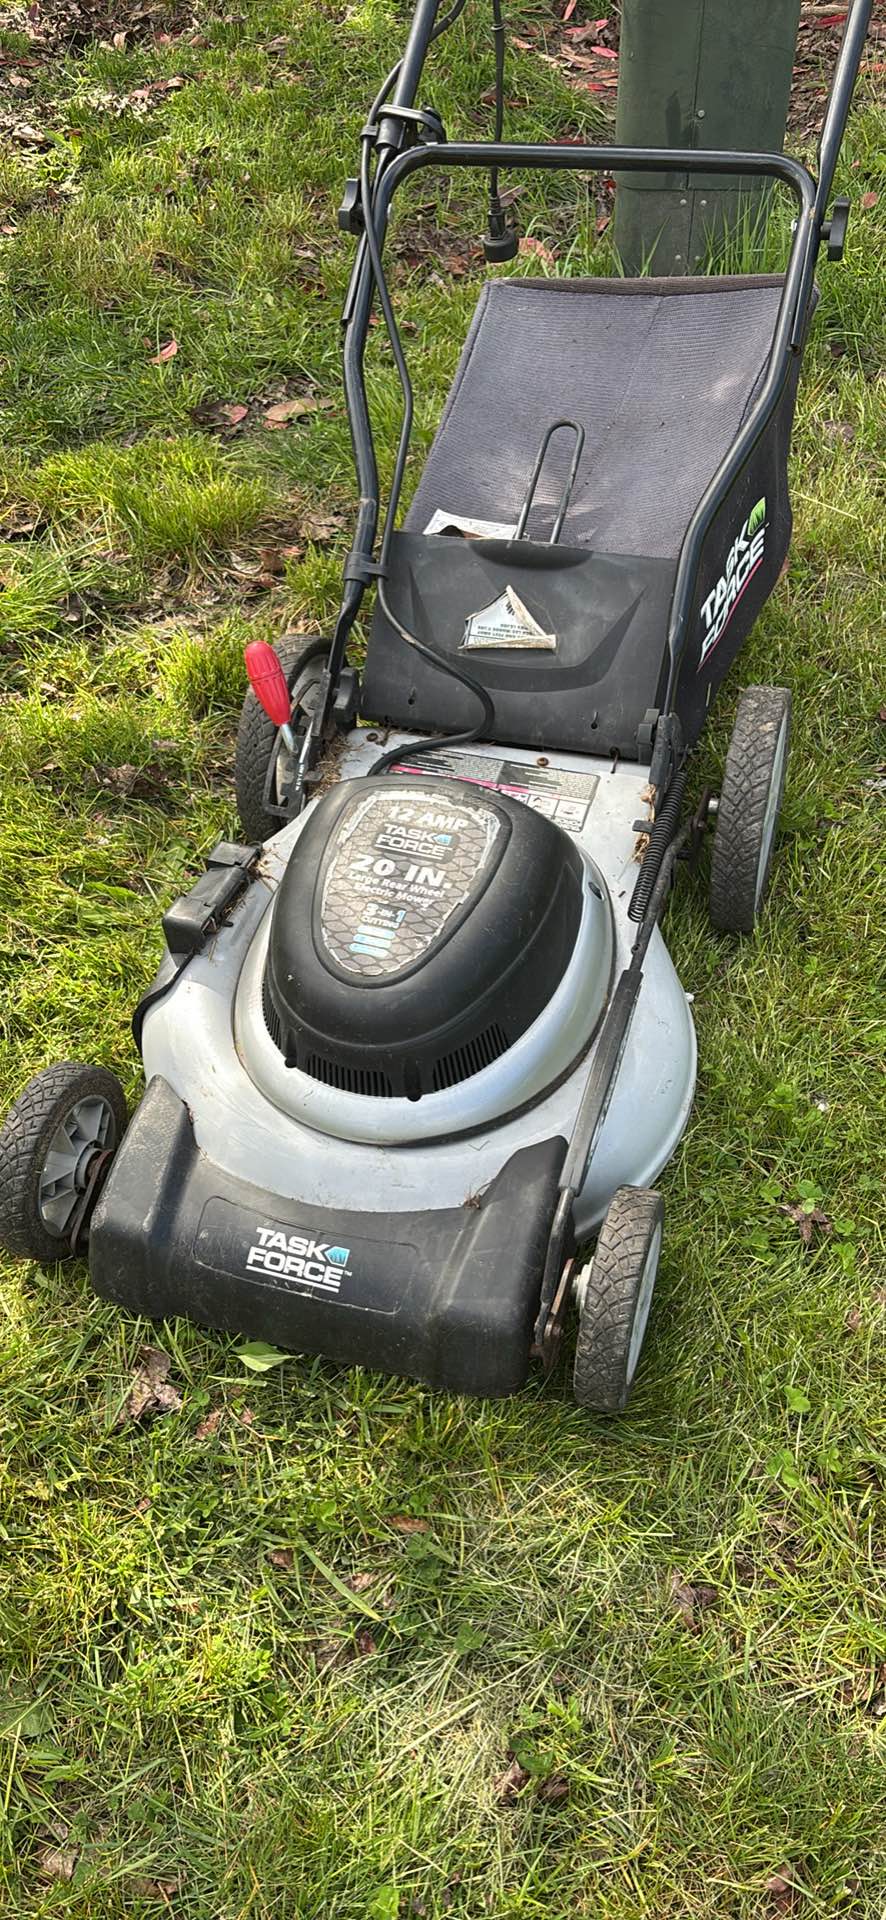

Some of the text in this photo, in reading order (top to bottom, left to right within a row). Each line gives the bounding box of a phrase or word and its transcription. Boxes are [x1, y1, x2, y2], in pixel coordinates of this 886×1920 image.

[700, 519, 750, 629] TASK
[700, 528, 766, 663] FORCE
[387, 806, 469, 831] 12 AMP
[376, 834, 449, 857] FORCE
[384, 823, 434, 843] TASK
[347, 871, 446, 898] Large Rear Wheel
[350, 854, 453, 890] 20 IN.
[353, 882, 435, 908] Electric Mower
[256, 1226, 331, 1262] TASK
